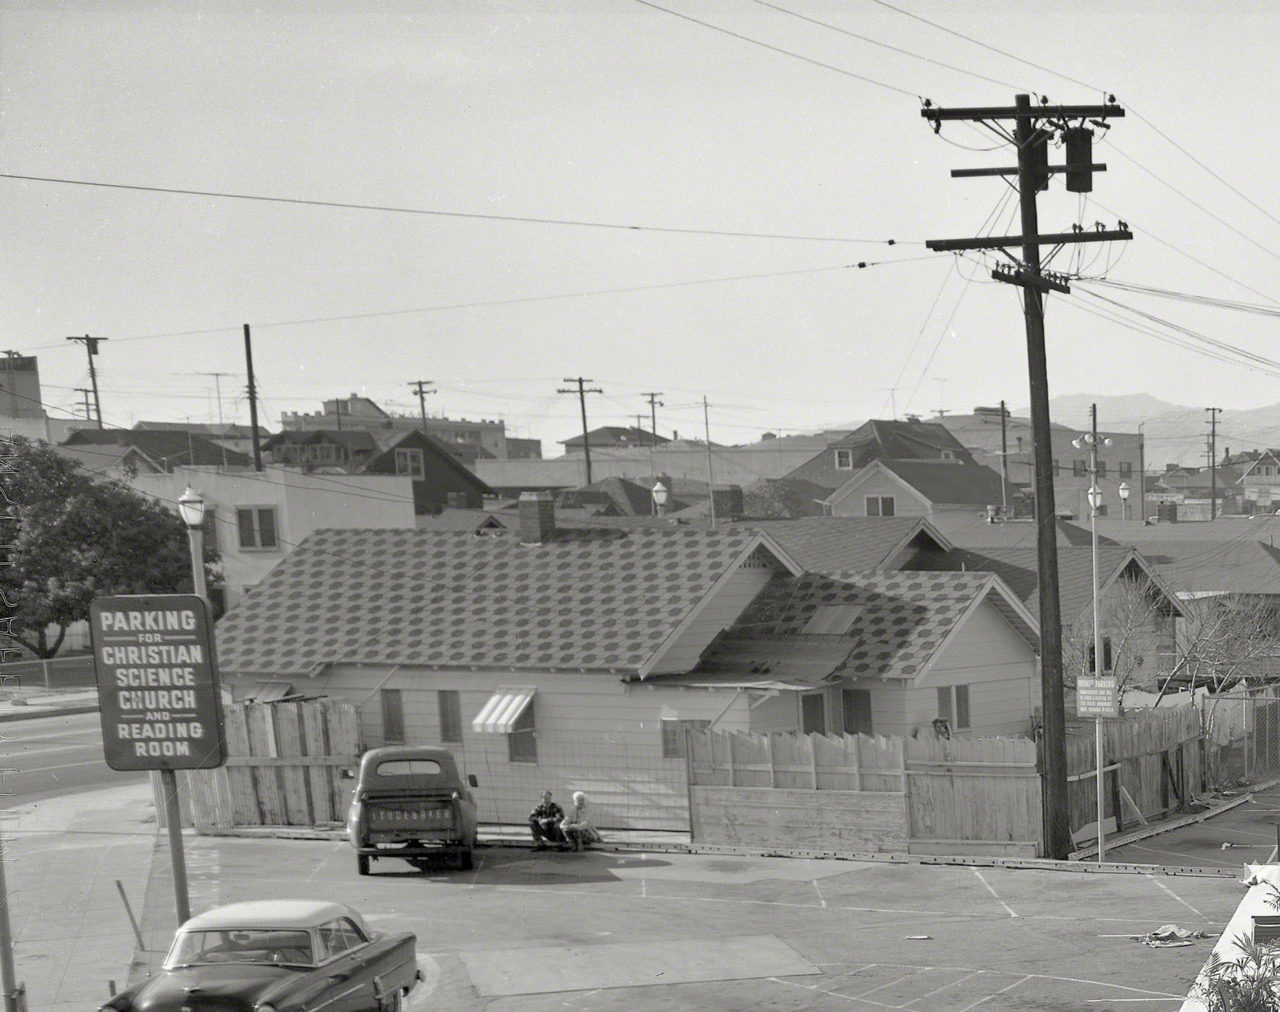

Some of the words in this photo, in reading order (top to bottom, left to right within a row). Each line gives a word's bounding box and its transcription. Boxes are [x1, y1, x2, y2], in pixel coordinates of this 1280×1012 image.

[100, 610, 196, 631] PARKING
[138, 633, 163, 643] FOR
[102, 644, 203, 665] CHRISTIAN
[115, 667, 195, 687] SCIENCE
[118, 690, 196, 710] CHURCH
[146, 711, 171, 720] AND
[117, 722, 203, 739] READING
[135, 741, 190, 757] ROOM
